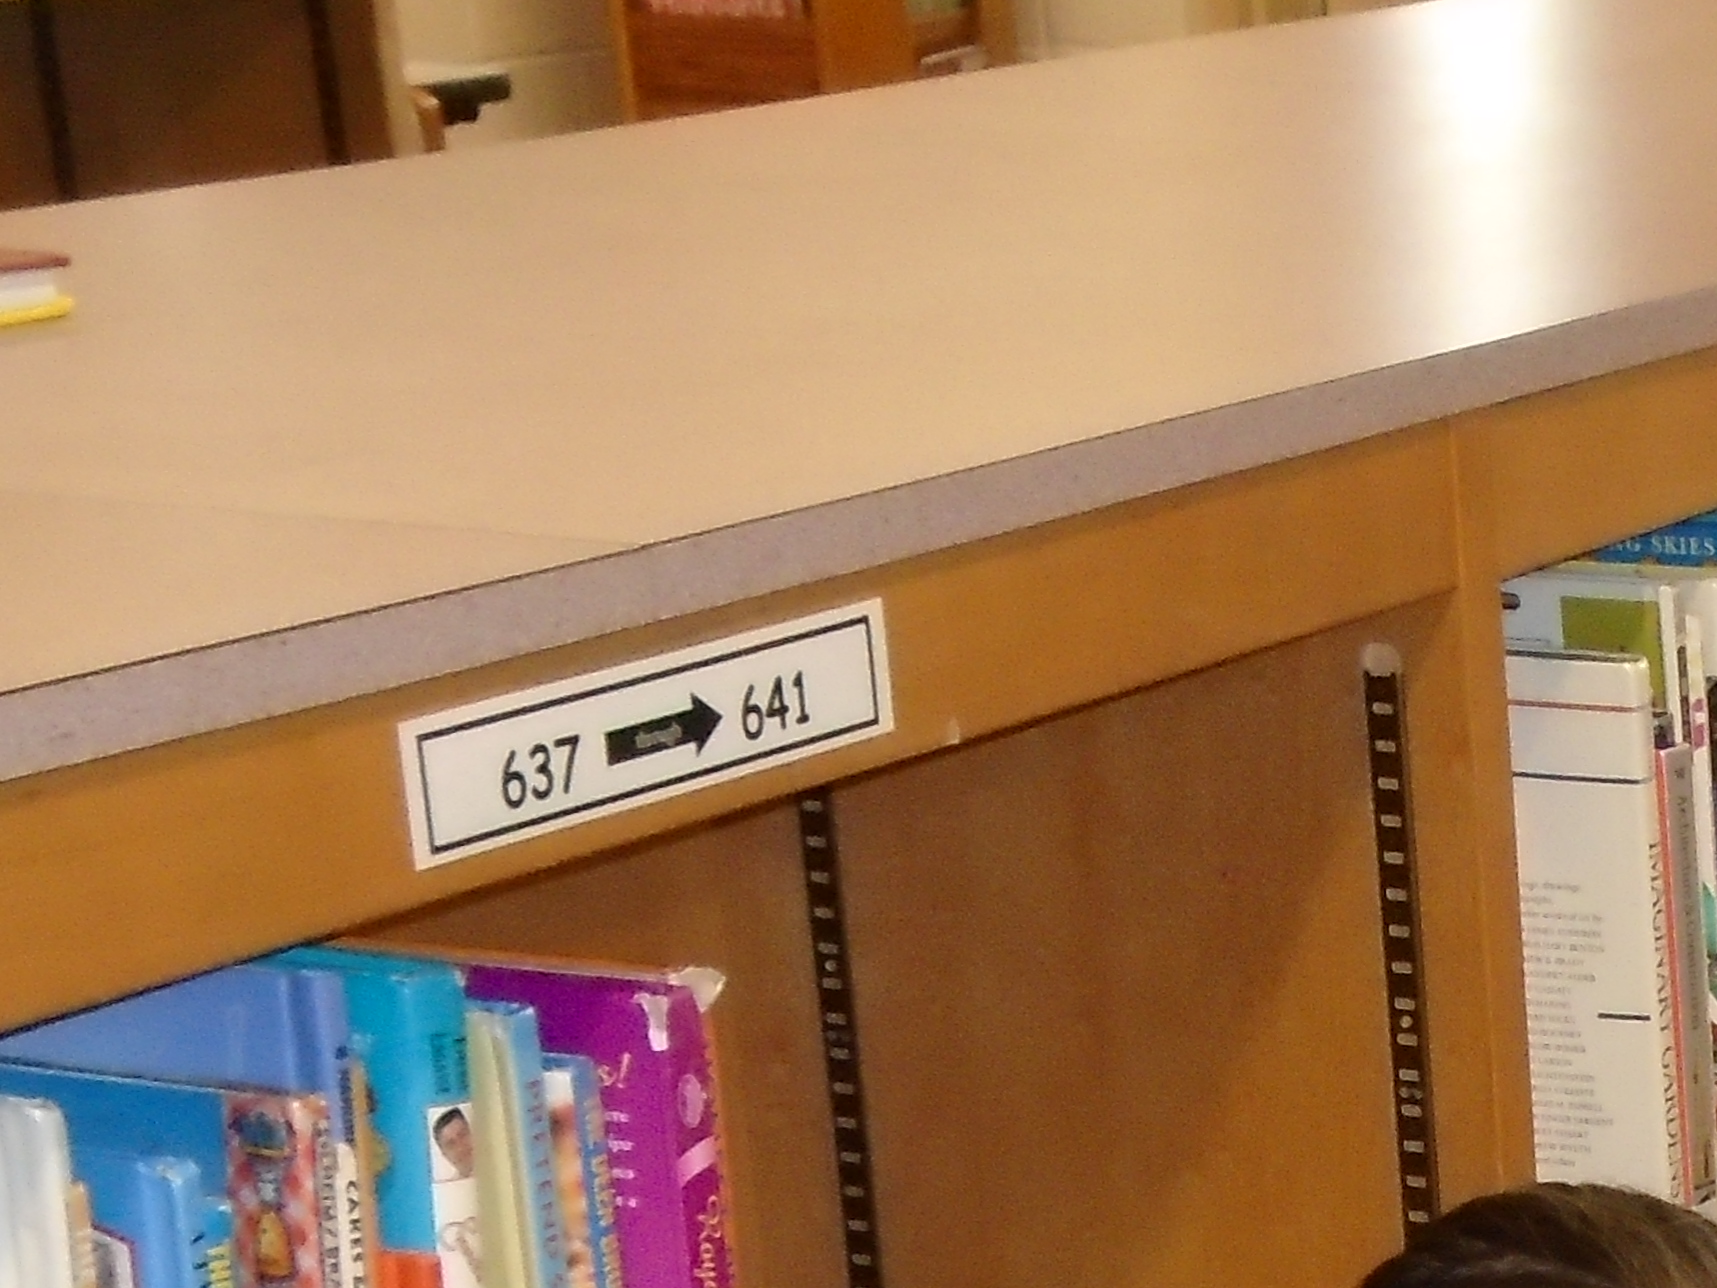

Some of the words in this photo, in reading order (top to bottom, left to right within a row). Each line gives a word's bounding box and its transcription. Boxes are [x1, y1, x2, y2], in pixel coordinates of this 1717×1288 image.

[1650, 535, 1716, 557] SKIES
[500, 735, 580, 810] 637
[741, 670, 811, 742] 641
[1649, 842, 1674, 1034] IMAGINARY
[346, 1180, 364, 1262] CAKES
[524, 1078, 561, 1262] PRETEND
